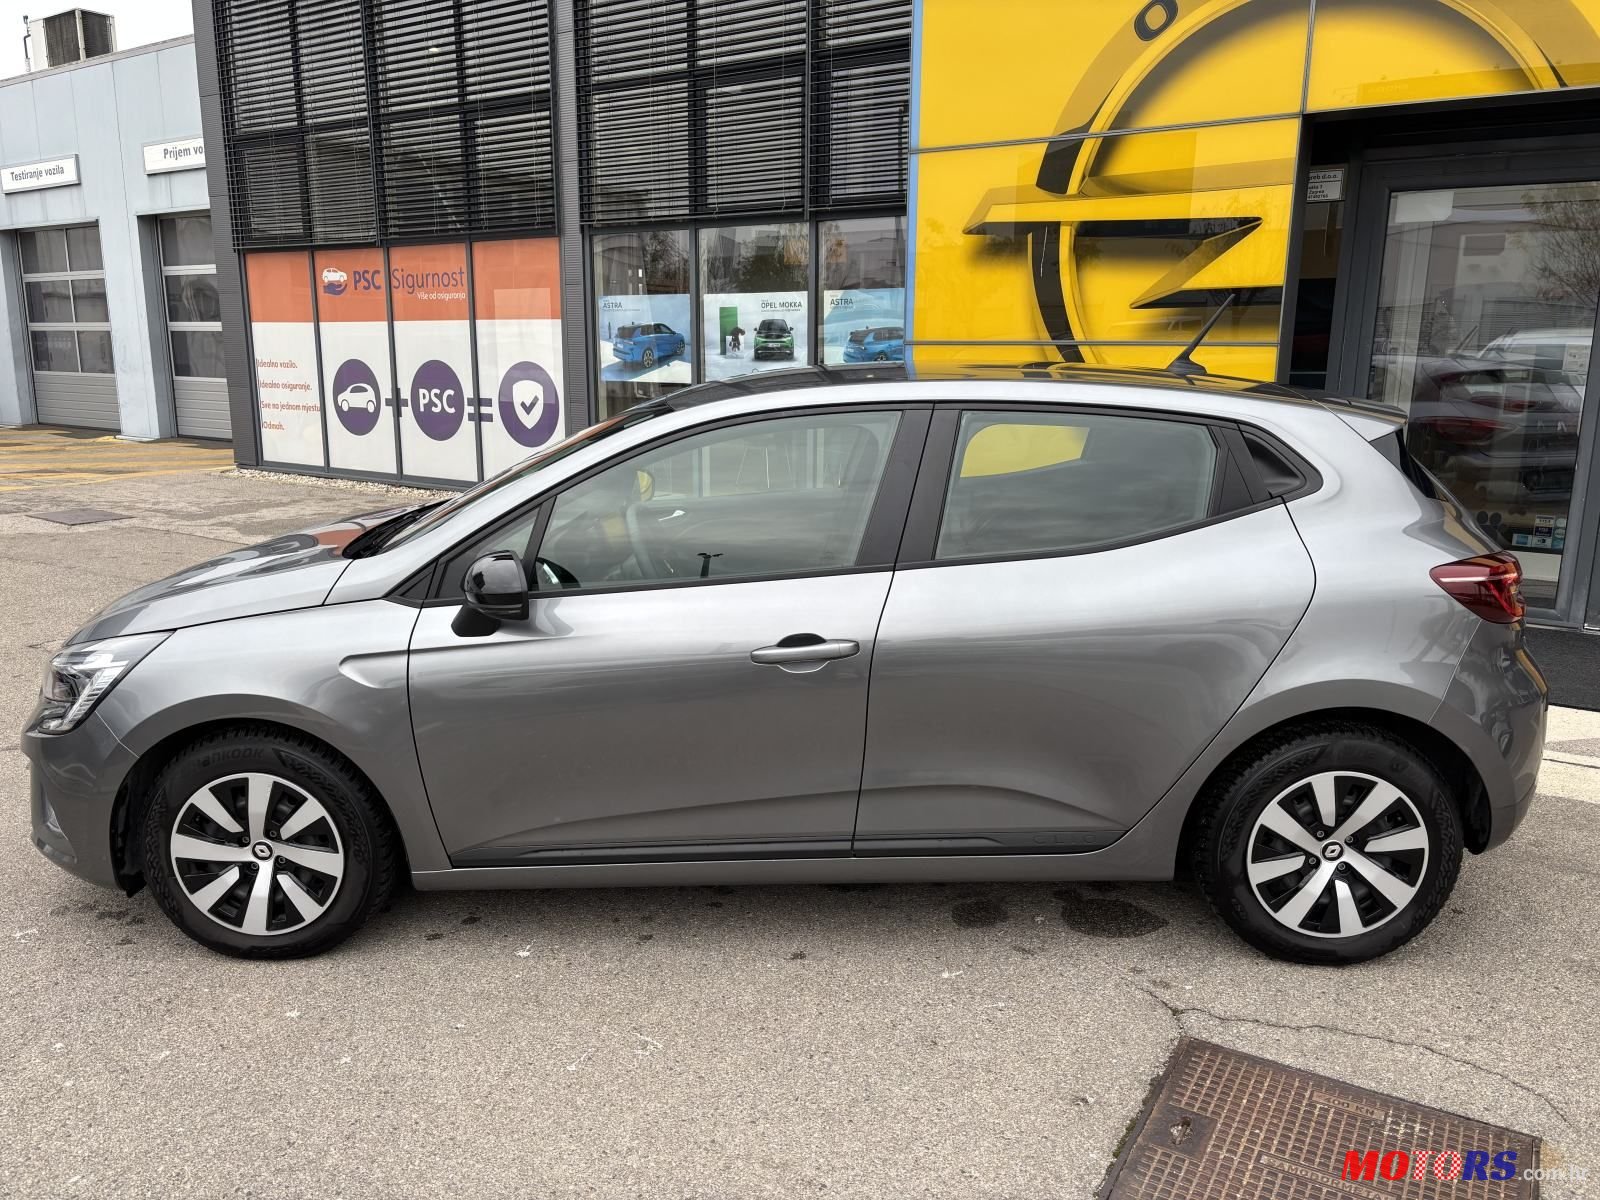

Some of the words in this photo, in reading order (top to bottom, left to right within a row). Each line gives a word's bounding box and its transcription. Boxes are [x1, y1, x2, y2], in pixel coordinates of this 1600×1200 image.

[163, 146, 191, 161] Prijem
[10, 169, 43, 182] Testiranje
[44, 165, 65, 176] vozila
[353, 269, 382, 291] PSC
[391, 266, 465, 295] Sigurnost
[429, 291, 437, 300] od
[779, 301, 803, 309] MOKKA
[830, 298, 853, 306] ASTRA
[280, 402, 302, 411] jednom
[418, 388, 456, 414] PSC
